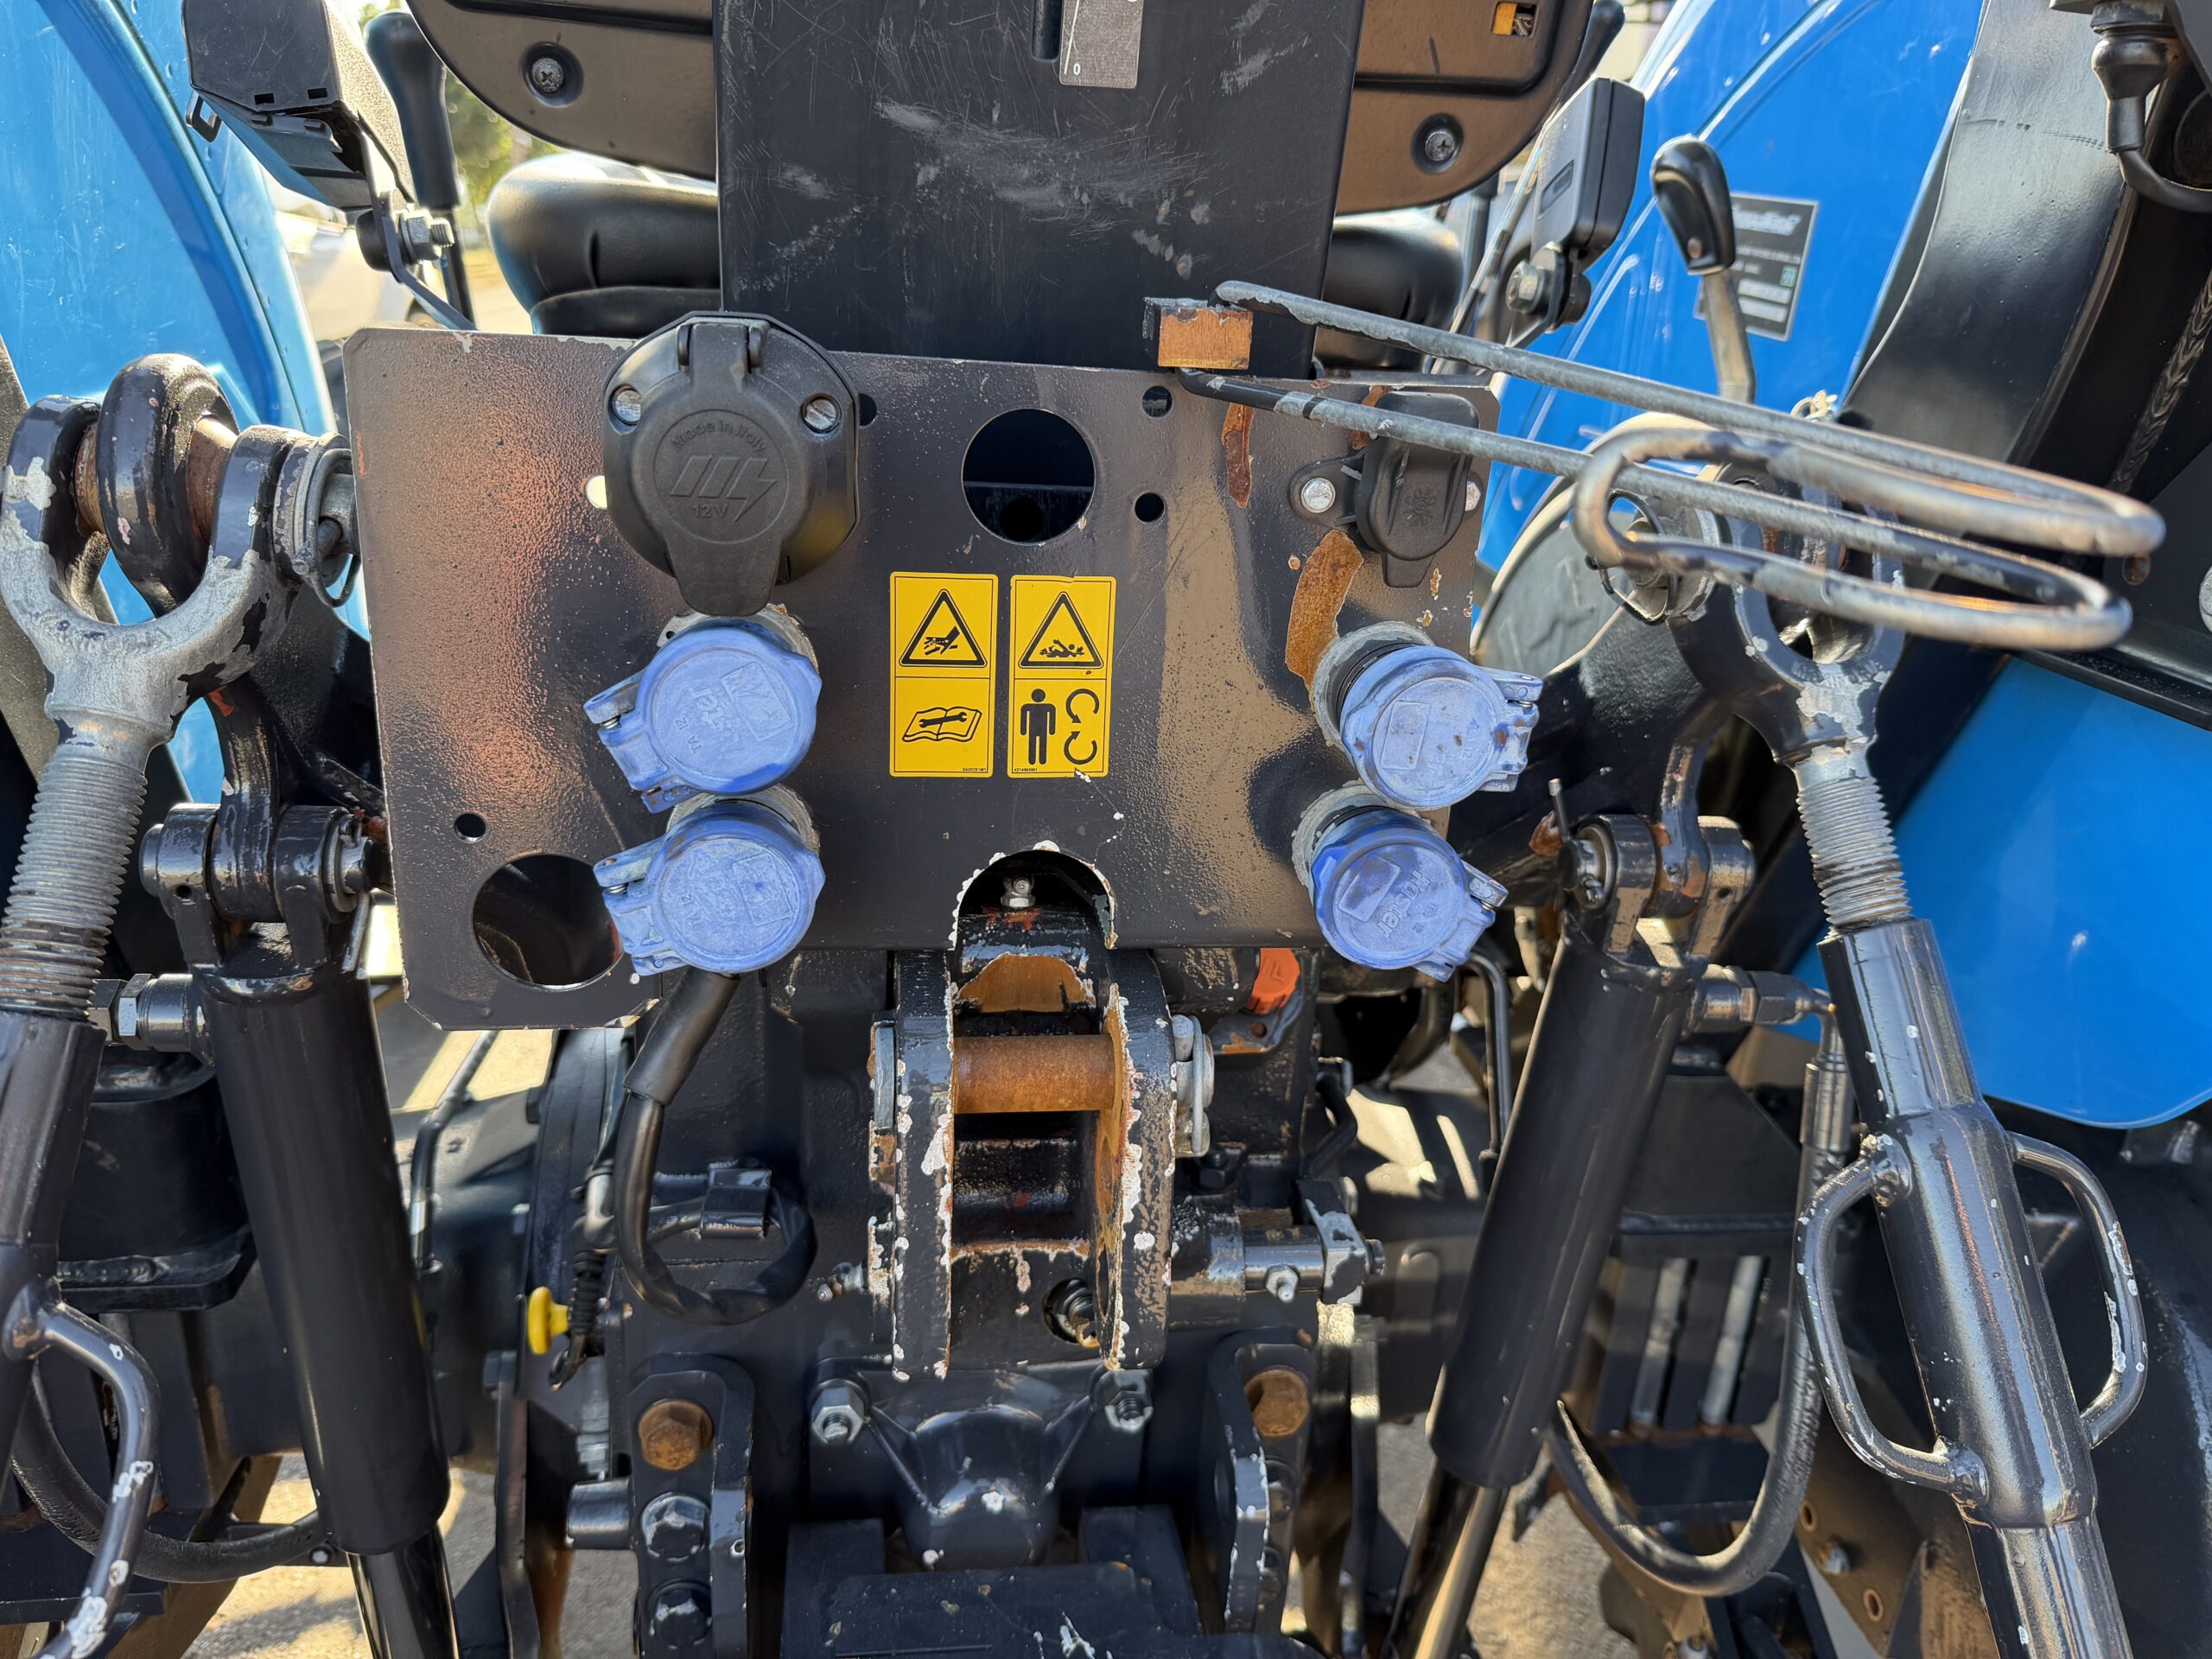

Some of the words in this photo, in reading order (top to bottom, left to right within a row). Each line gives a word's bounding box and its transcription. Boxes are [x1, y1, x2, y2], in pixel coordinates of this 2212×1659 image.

[671, 421, 715, 449] Made
[734, 424, 767, 453] Italy
[1377, 869, 1431, 939] Faster
